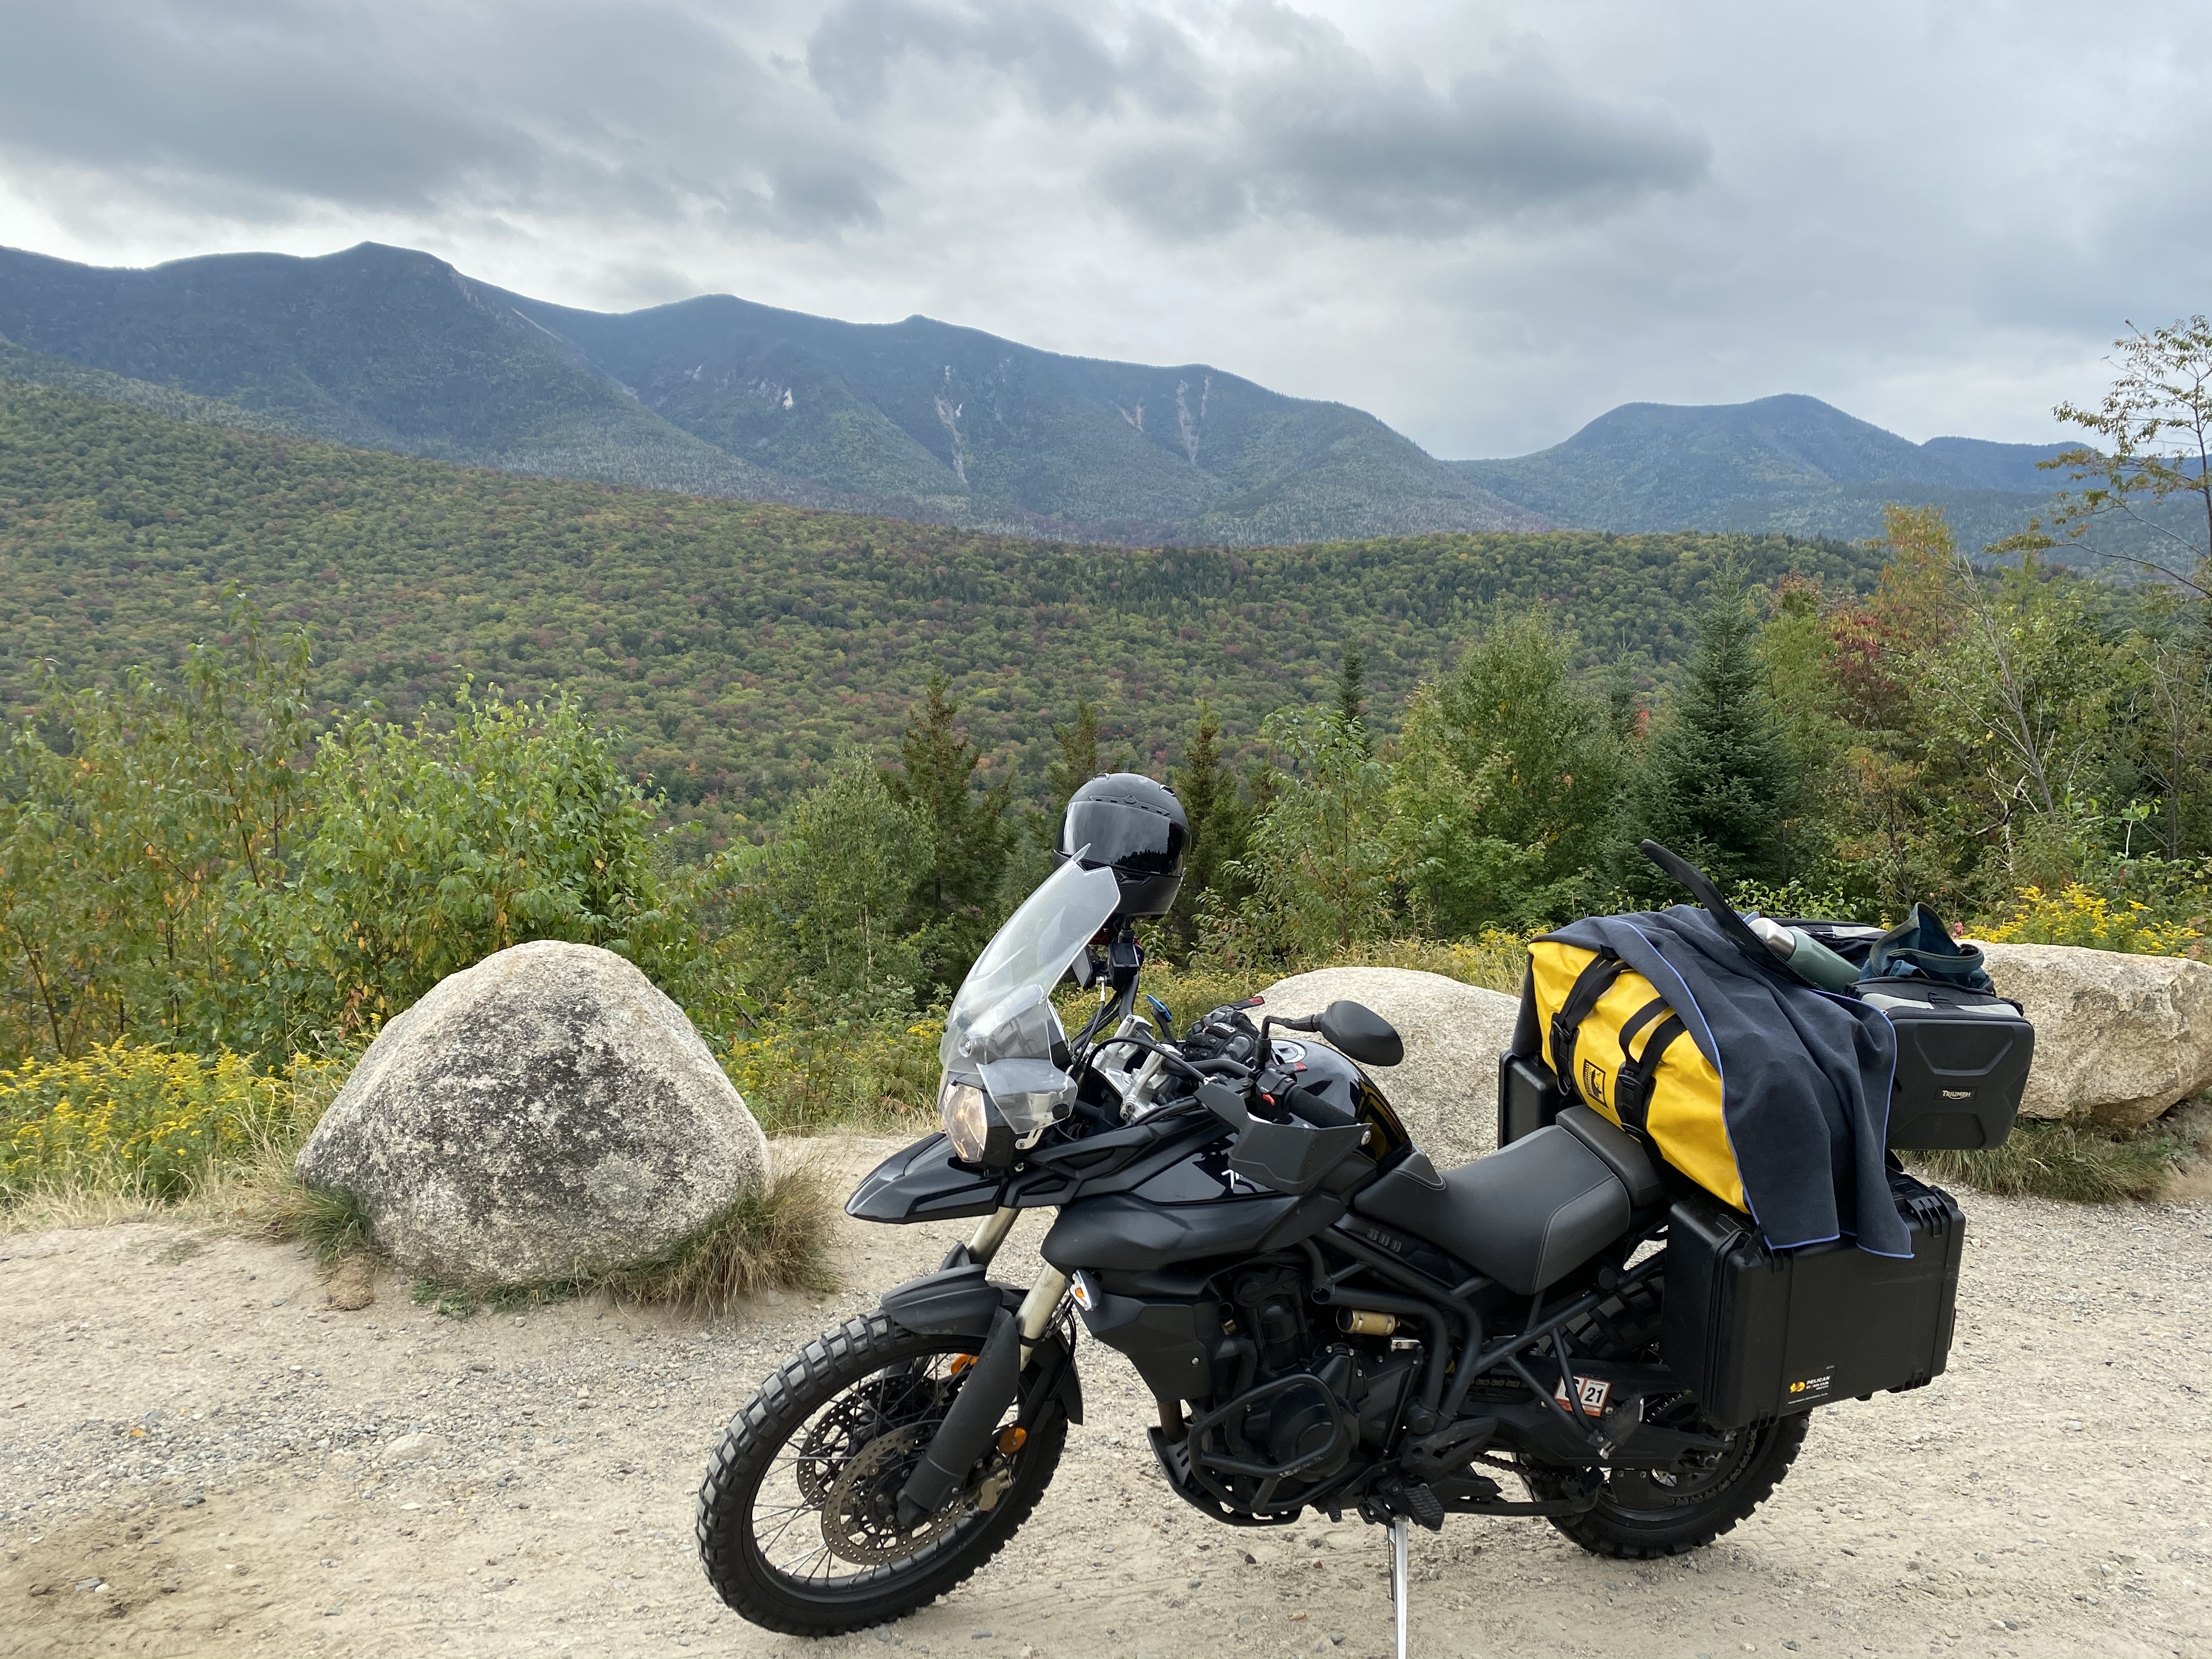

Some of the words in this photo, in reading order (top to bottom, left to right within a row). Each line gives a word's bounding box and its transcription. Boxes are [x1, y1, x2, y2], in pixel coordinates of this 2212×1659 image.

[1942, 1090, 1971, 1100] TRIUMPH
[1367, 1228, 1402, 1252] 800
[1807, 1376, 1831, 1385] PELICAN
[1584, 1387, 1604, 1403] 21
